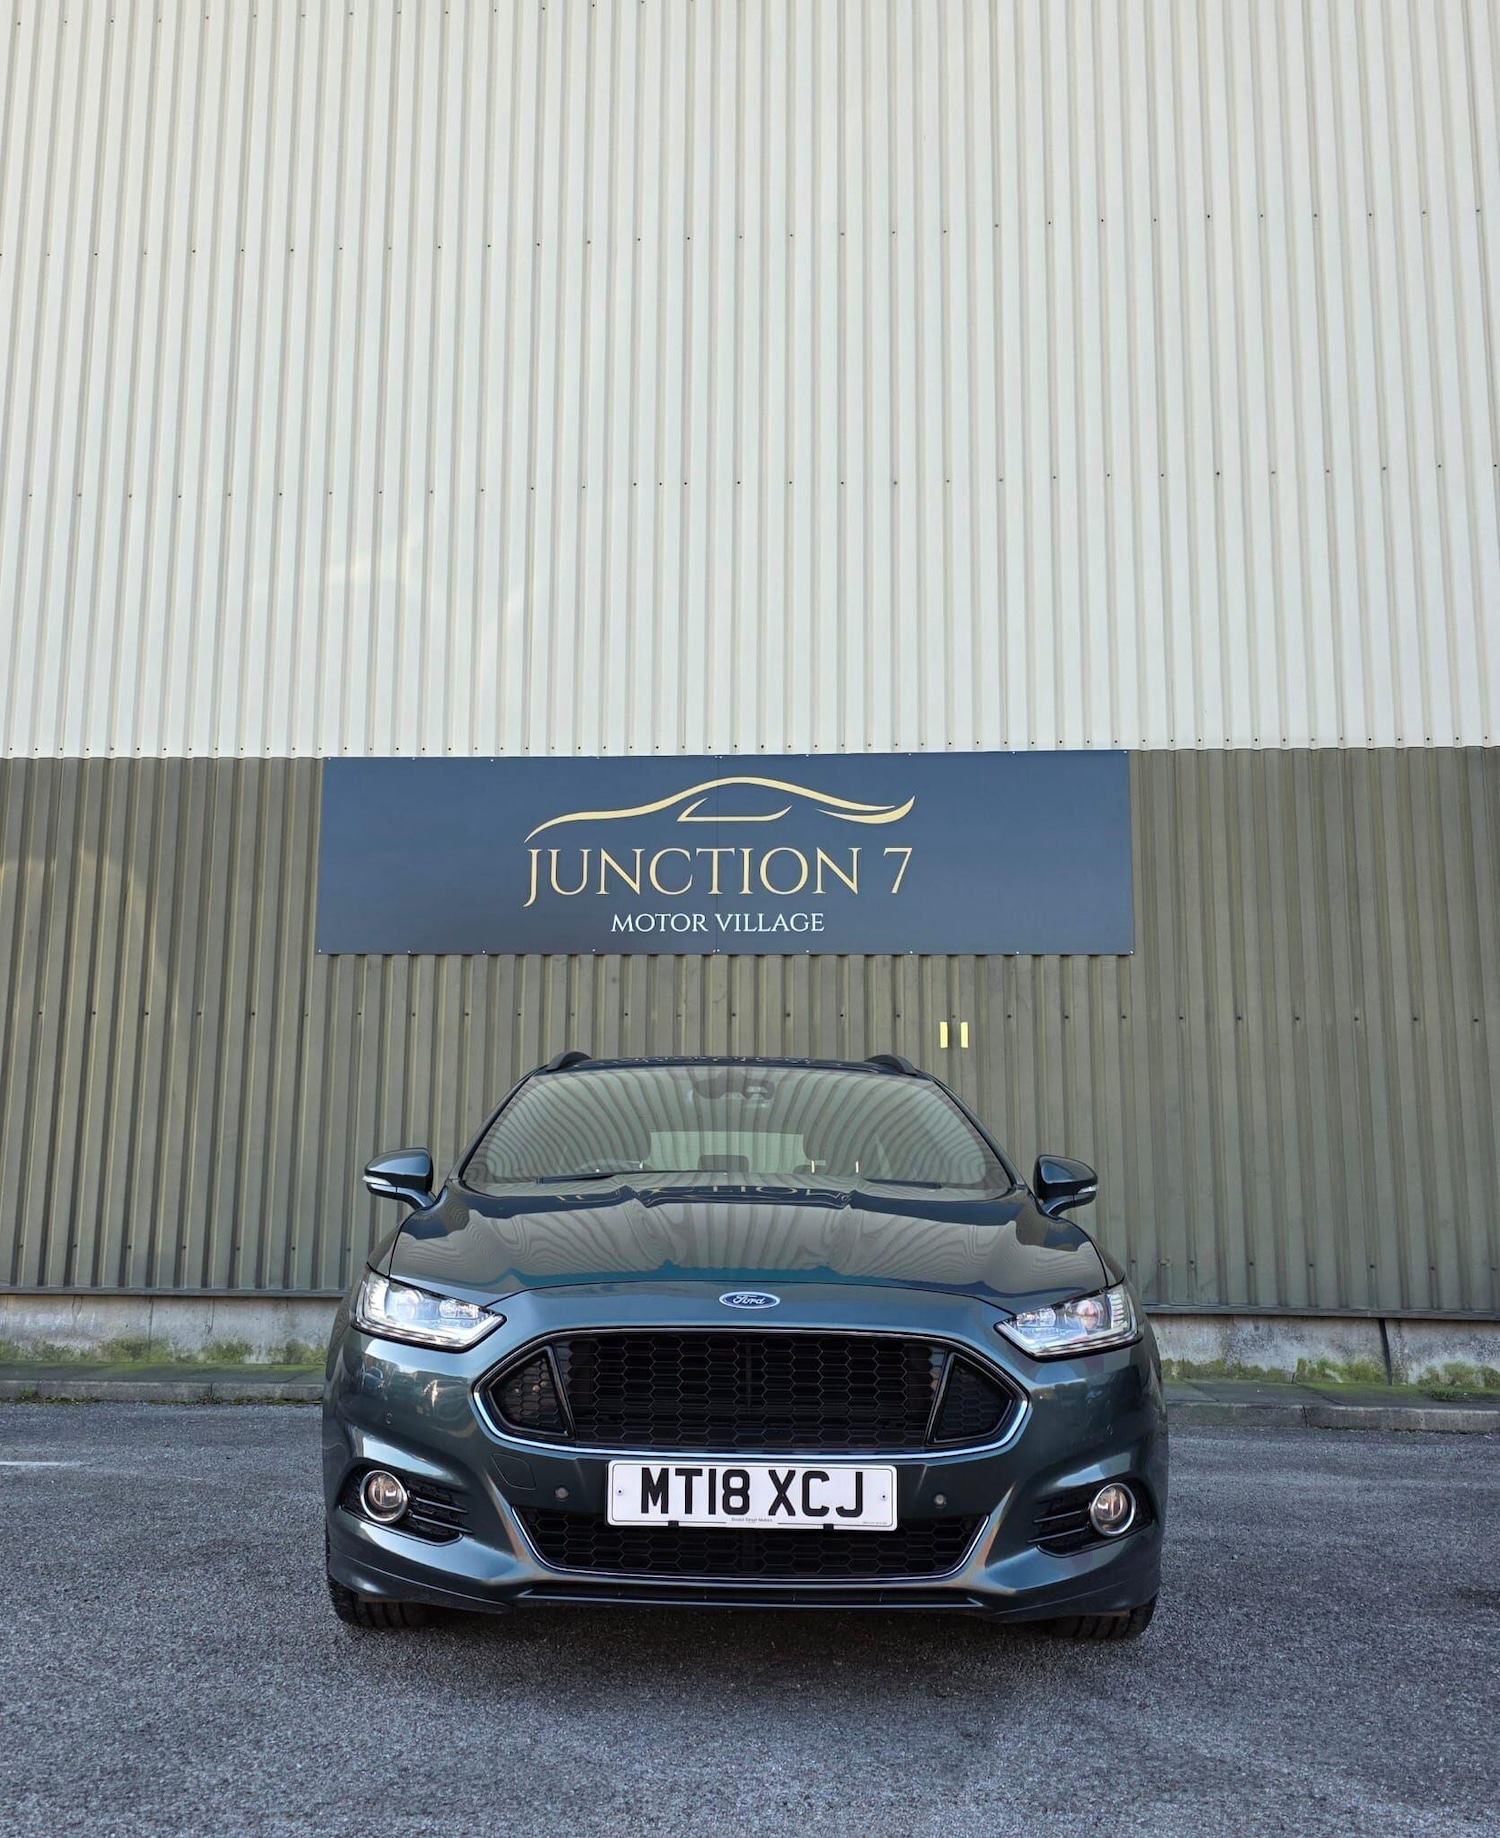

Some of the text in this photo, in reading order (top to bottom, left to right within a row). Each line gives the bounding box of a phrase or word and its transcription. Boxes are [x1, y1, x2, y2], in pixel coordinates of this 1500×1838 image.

[522, 847, 913, 908] JUNCTION 7
[610, 912, 825, 933] MOTOR VILLAGE
[732, 1294, 766, 1305] Ford
[640, 1467, 864, 1518] MT18 XCJ
